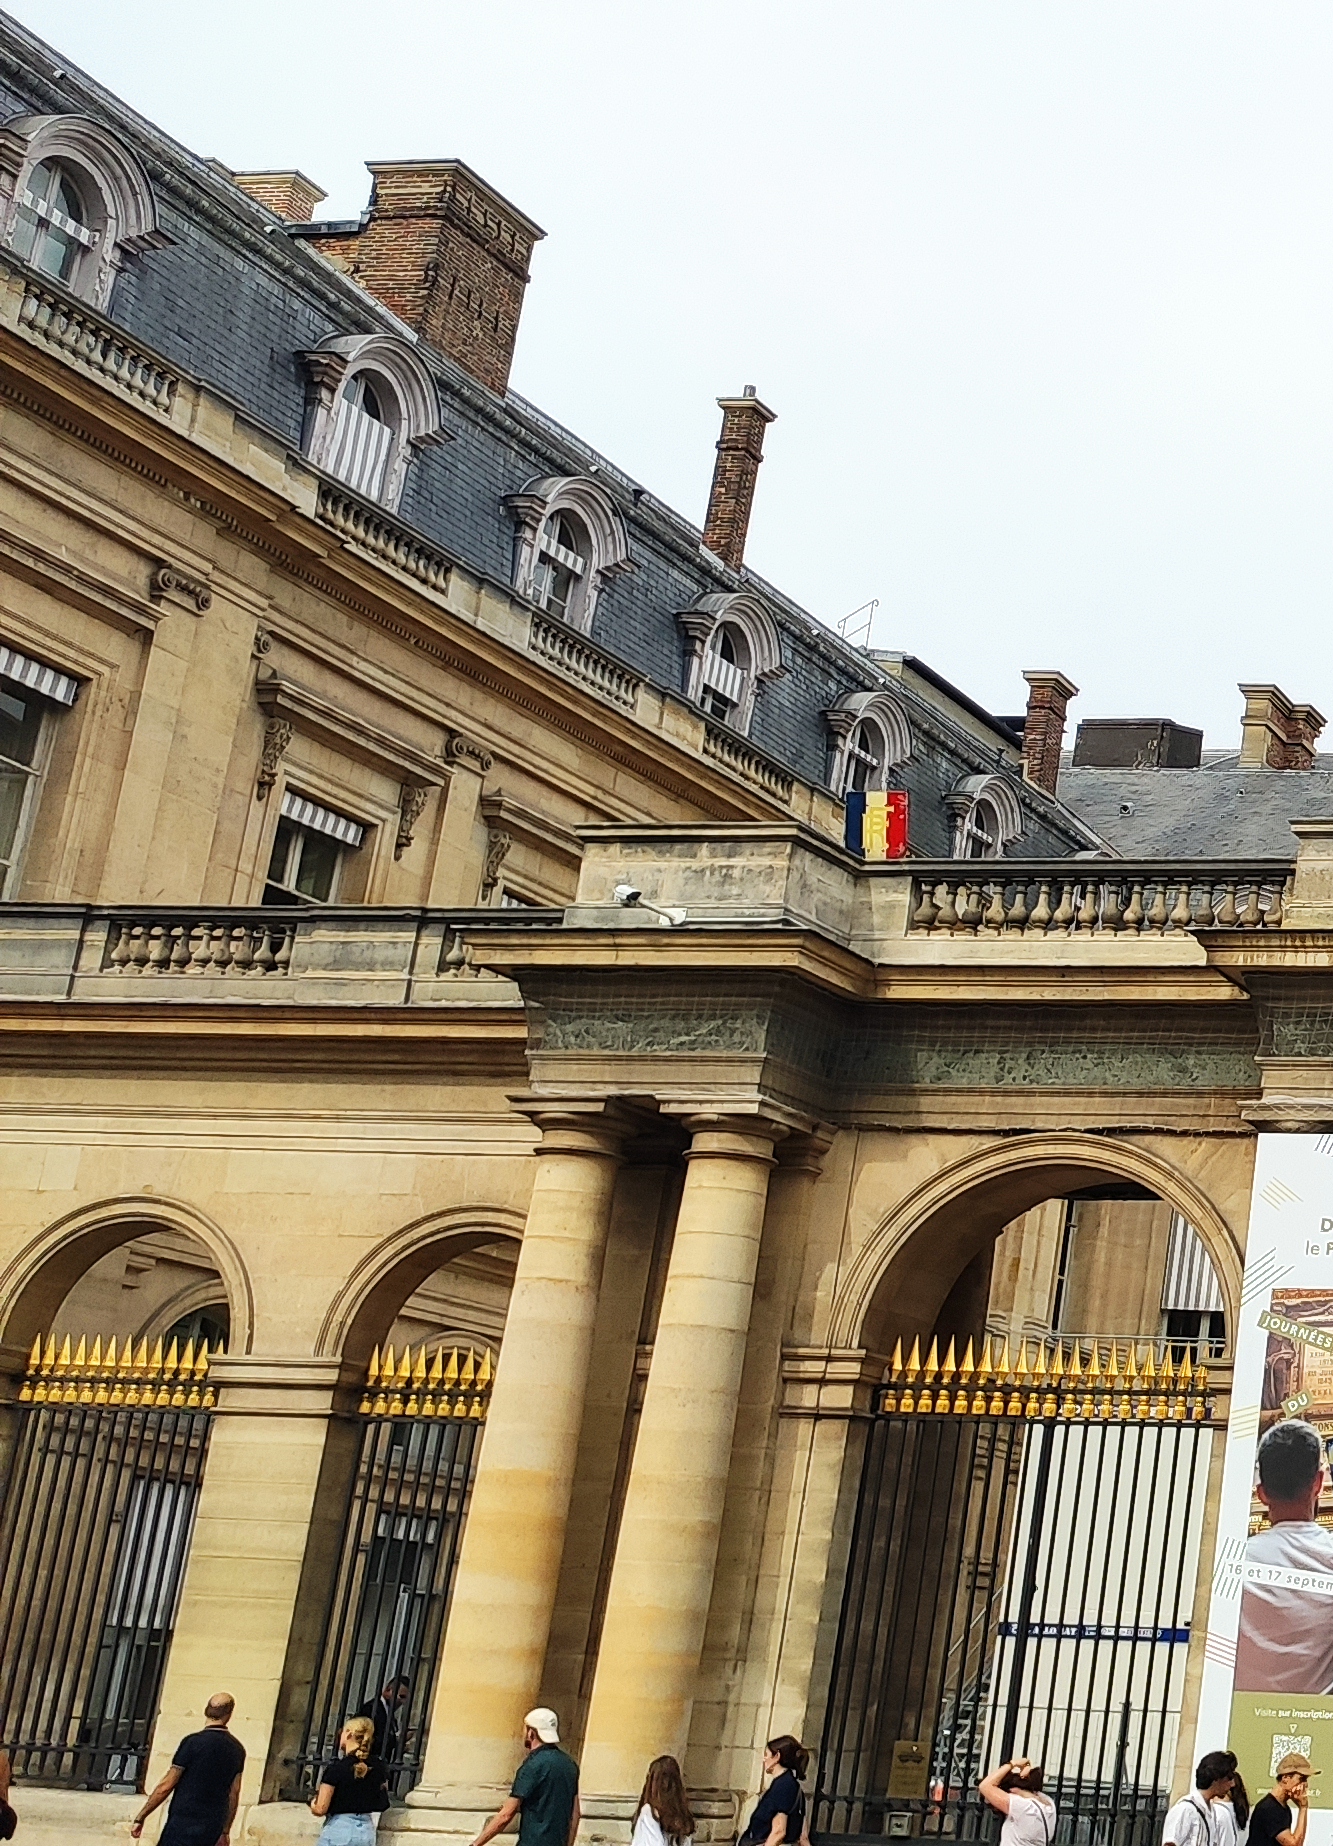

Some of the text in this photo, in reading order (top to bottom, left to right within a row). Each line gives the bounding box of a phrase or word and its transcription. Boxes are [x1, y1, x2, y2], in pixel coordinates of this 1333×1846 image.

[1305, 1240, 1320, 1256] le
[1262, 1314, 1333, 1348] JOURNÉES
[1287, 1393, 1308, 1412] DU
[1228, 1563, 1242, 1575] 16
[1248, 1569, 1262, 1578] et
[1268, 1569, 1281, 1581] 17
